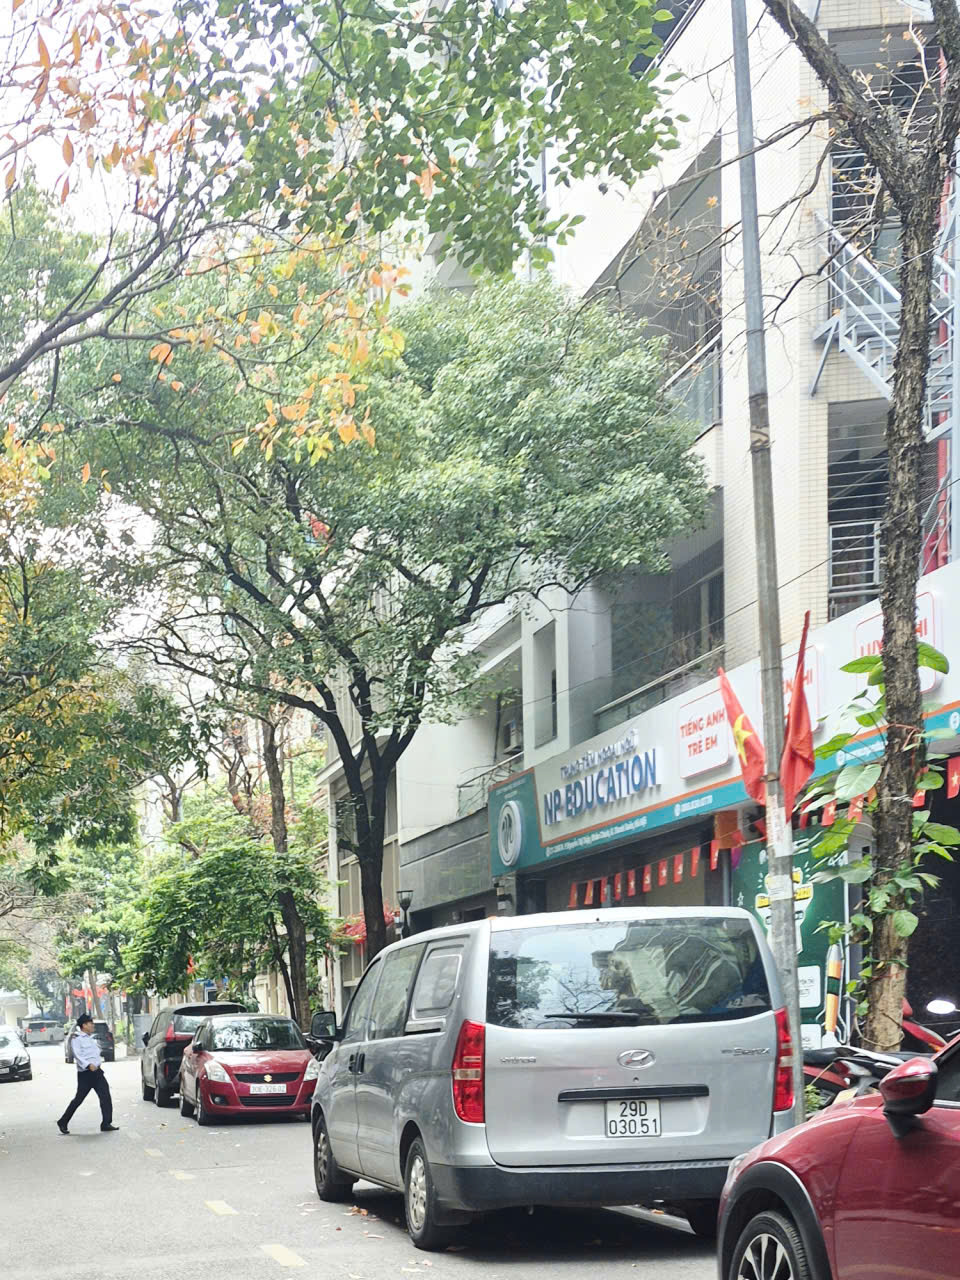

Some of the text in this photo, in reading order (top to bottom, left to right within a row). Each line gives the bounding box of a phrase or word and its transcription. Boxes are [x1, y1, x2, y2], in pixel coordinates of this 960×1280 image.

[706, 707, 725, 728] ANH
[704, 735, 718, 752] EM
[544, 788, 562, 825] NP
[565, 748, 657, 817] EDUCATION
[619, 1100, 648, 1117] 29D
[609, 1118, 658, 1135] 030.51
